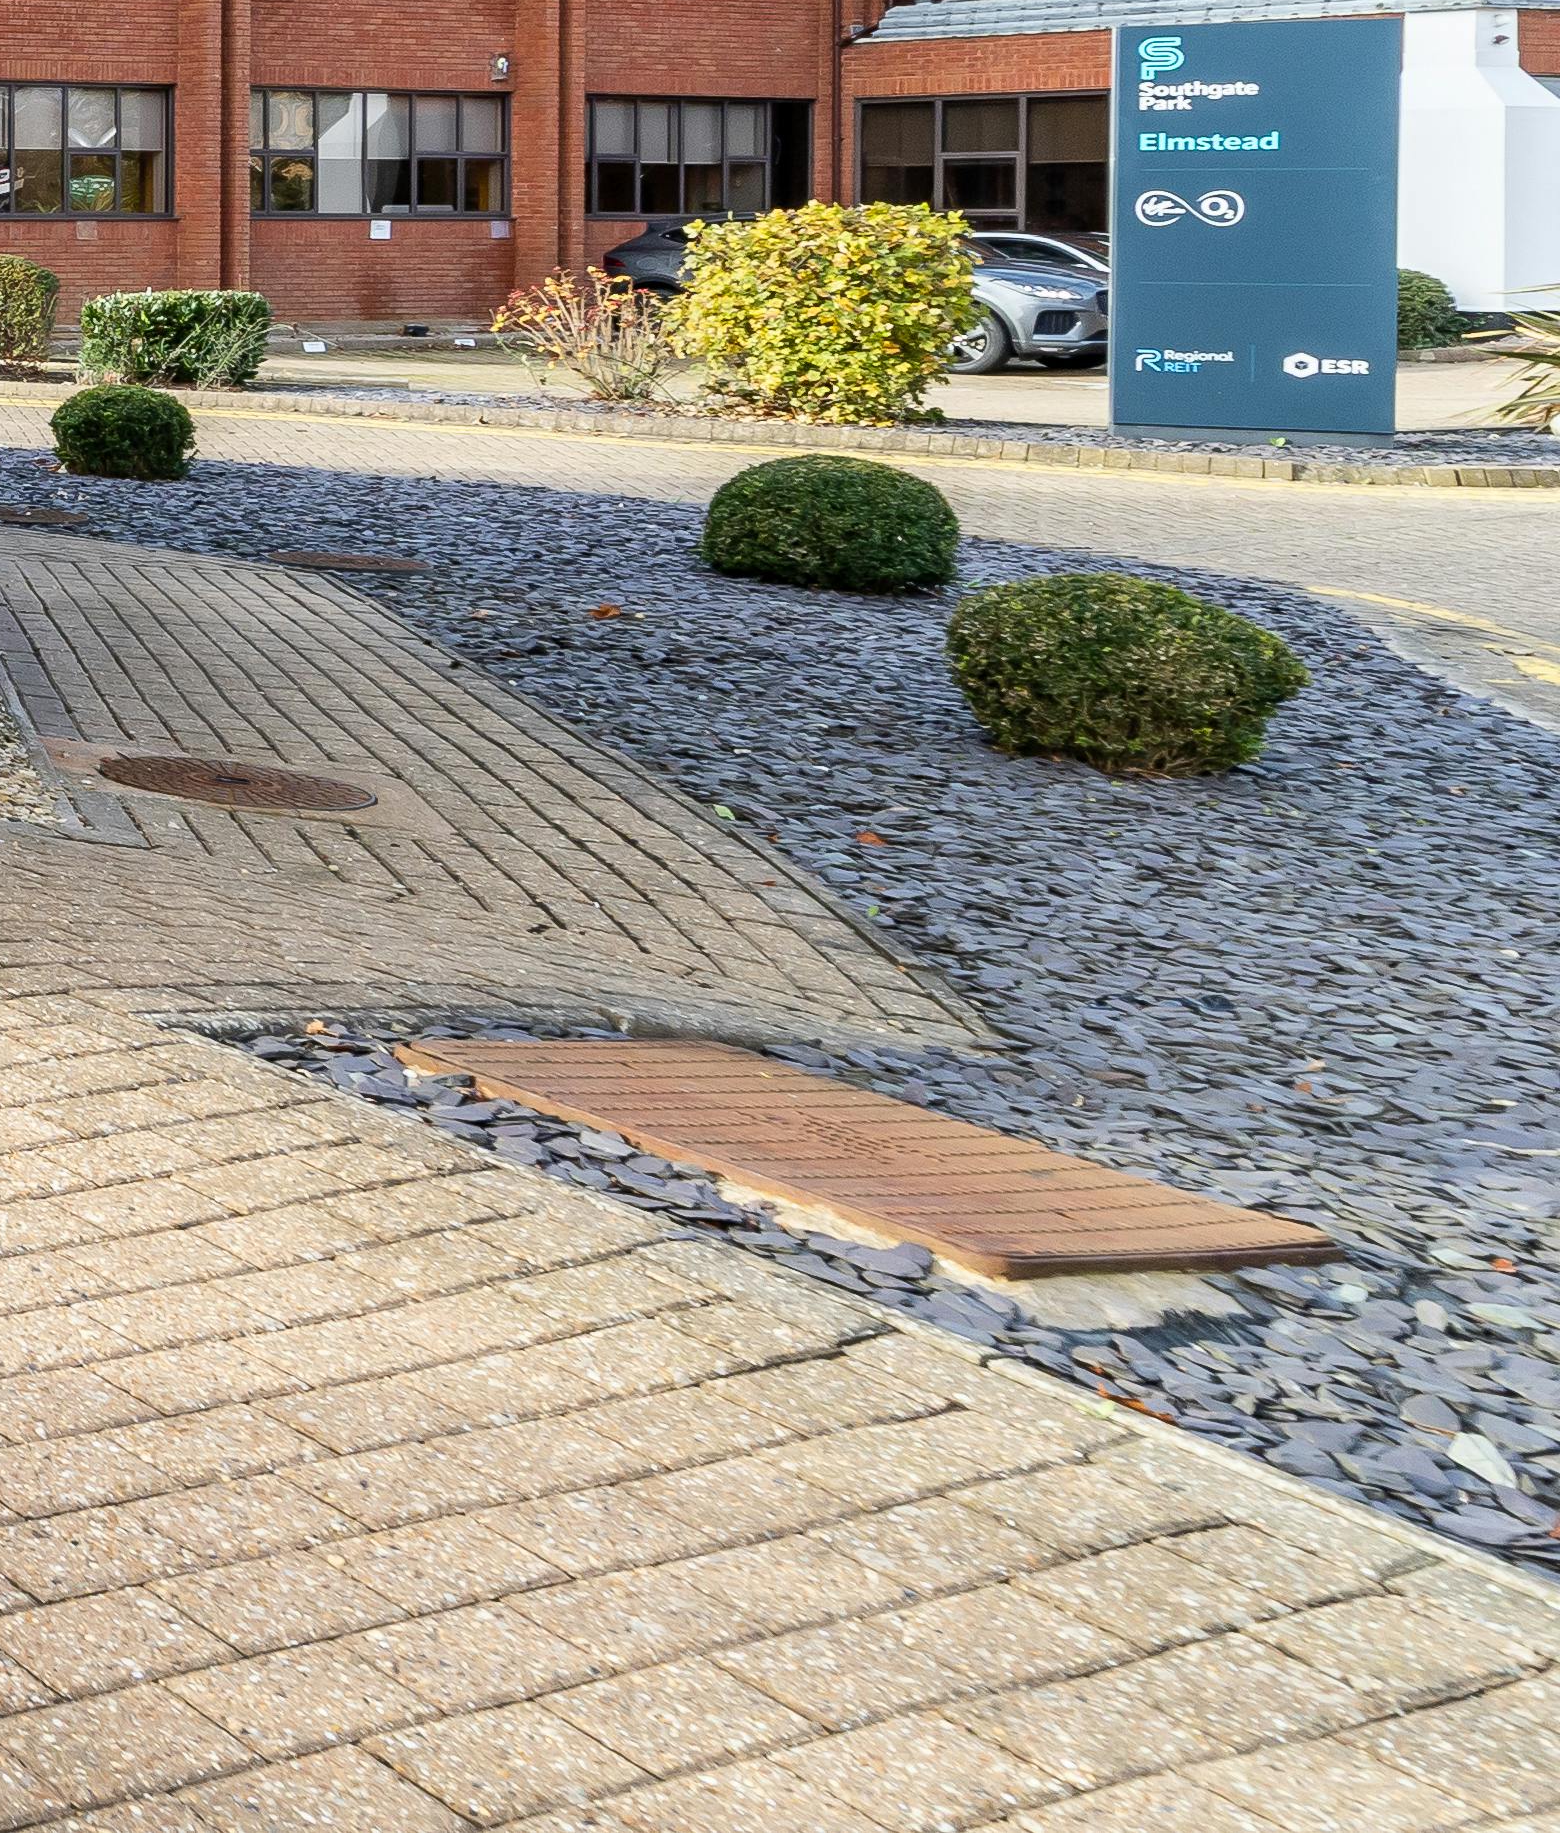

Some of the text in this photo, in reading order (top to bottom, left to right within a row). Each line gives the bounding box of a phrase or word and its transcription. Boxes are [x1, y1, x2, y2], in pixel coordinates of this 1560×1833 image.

[1138, 81, 1260, 101] Southgate
[1138, 96, 1193, 111] Park
[1138, 131, 1280, 152] Elmstead
[1163, 349, 1235, 362] Regional
[1163, 362, 1202, 374] REIT
[1320, 359, 1370, 375] ESR
